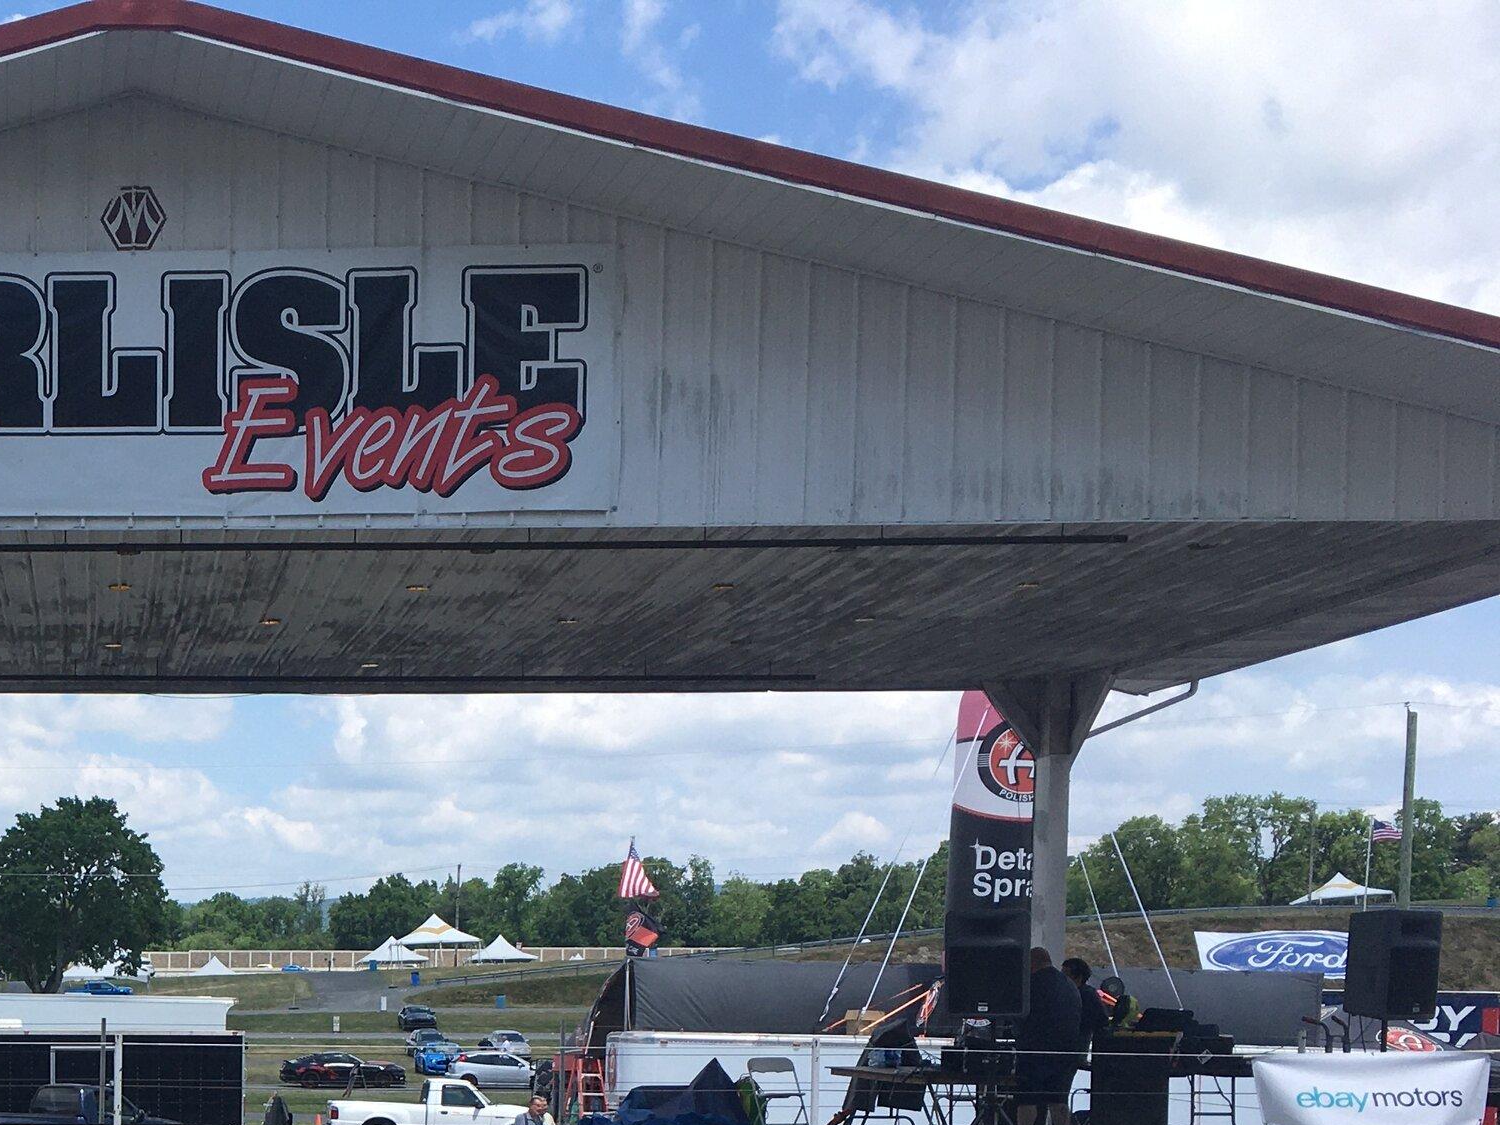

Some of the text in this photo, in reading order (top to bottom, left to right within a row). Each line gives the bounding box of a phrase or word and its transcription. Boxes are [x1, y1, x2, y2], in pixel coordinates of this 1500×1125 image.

[203, 374, 583, 501] Events
[1248, 940, 1348, 968] Ford
[1297, 1086, 1463, 1112] ebay motors
